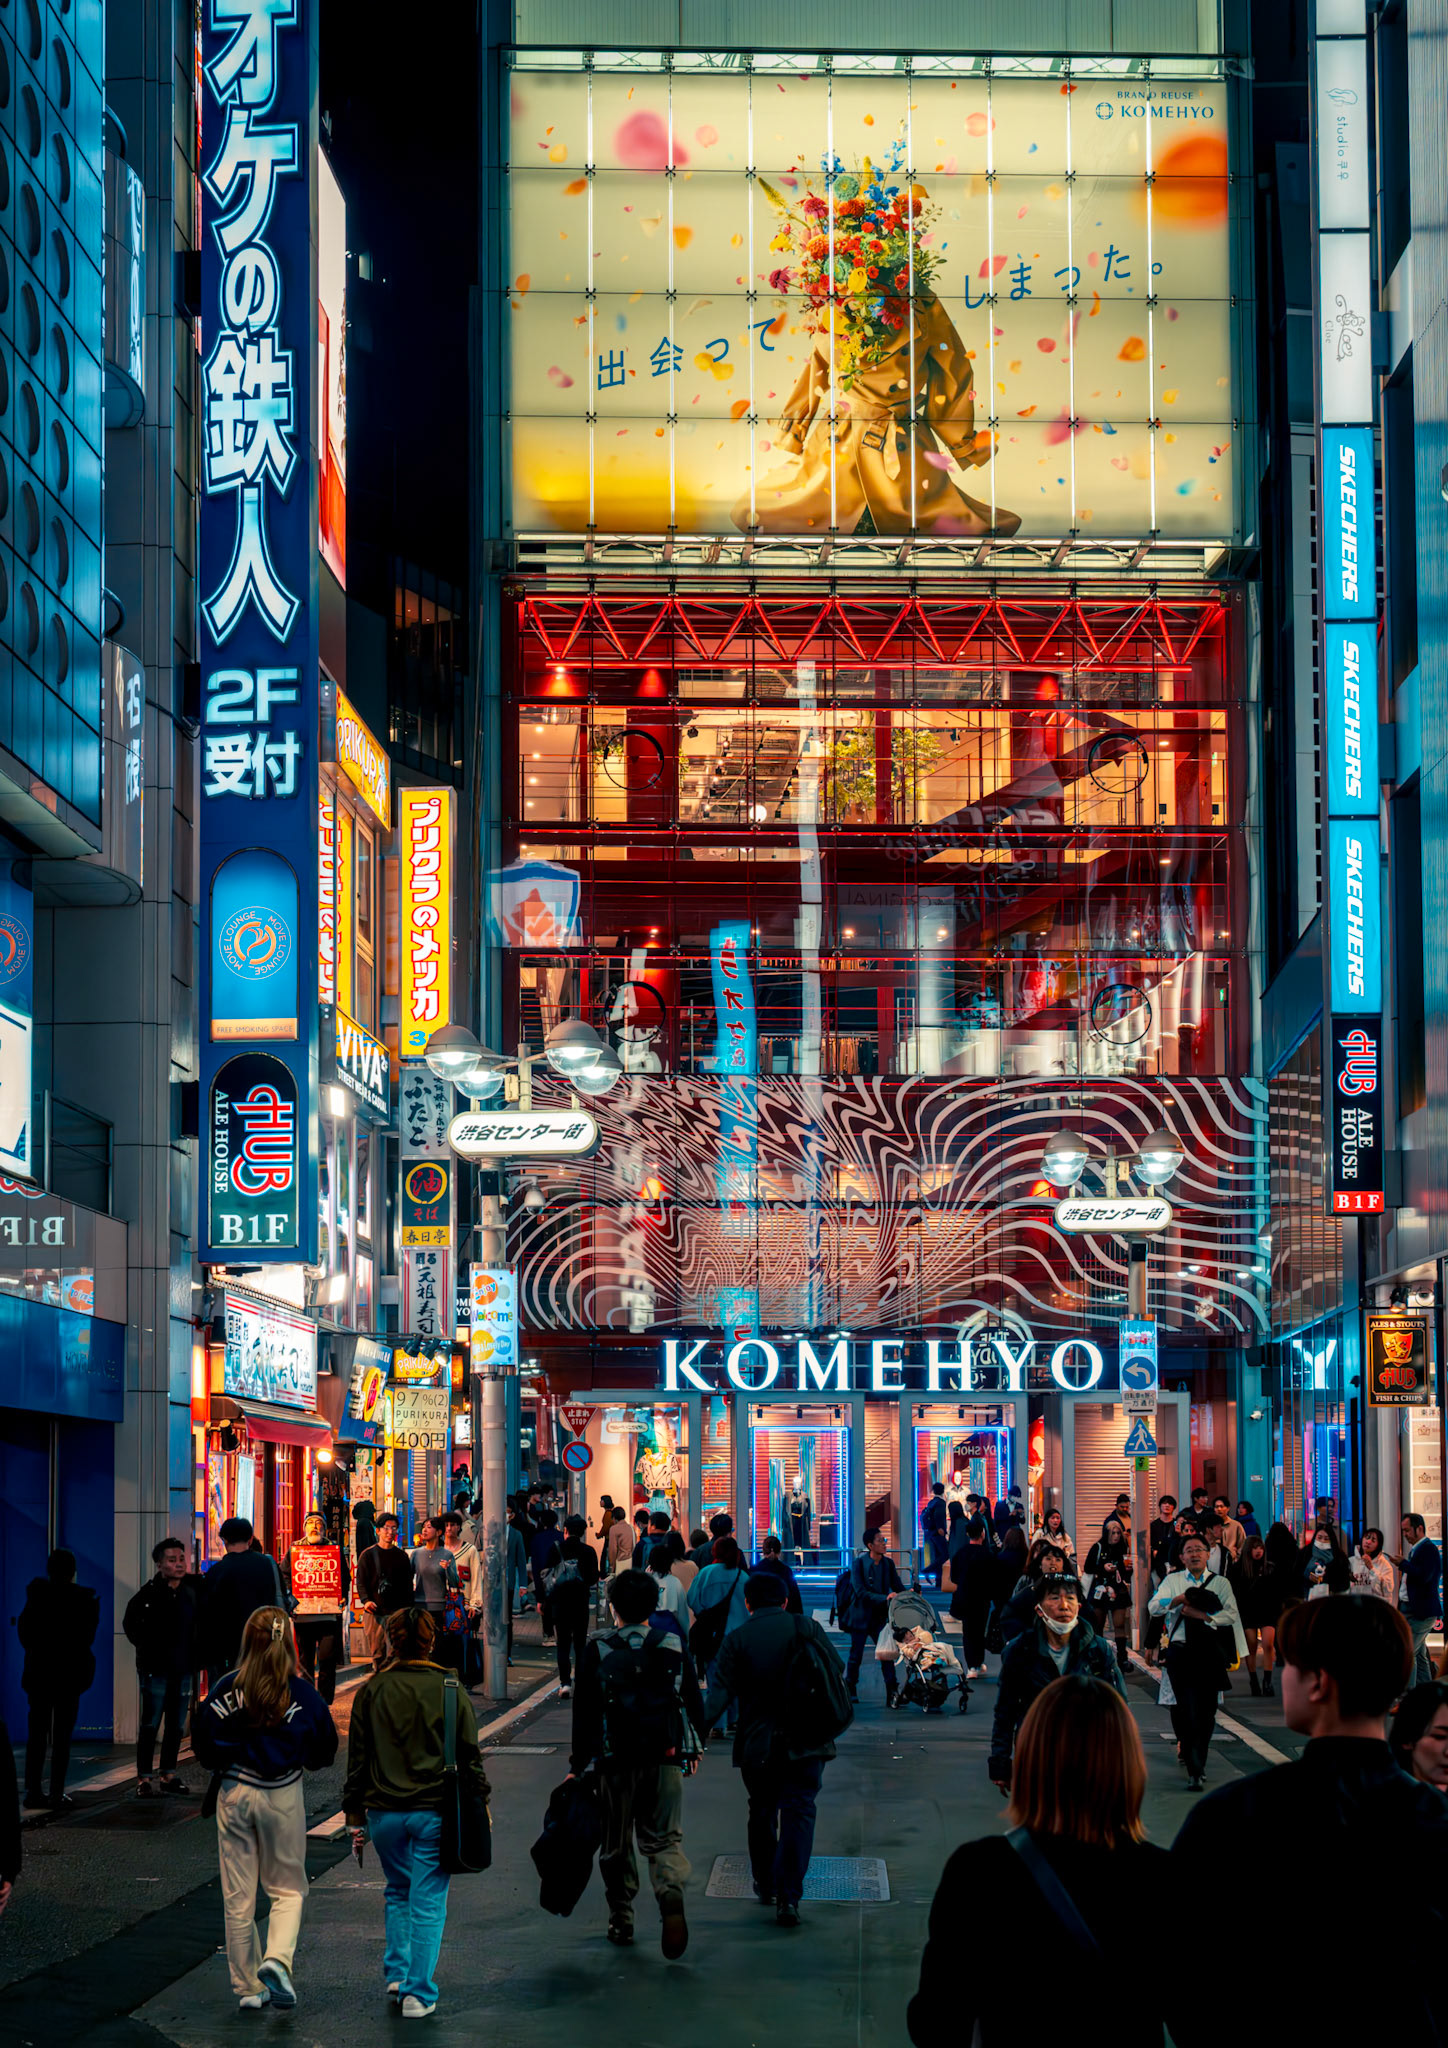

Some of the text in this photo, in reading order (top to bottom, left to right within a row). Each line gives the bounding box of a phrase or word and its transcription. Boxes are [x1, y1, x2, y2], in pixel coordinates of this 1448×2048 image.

[1117, 91, 1193, 100] BRAND REUSE
[1121, 105, 1214, 118] KOMEHYO
[1337, 116, 1348, 157] studio
[597, 317, 777, 391] 出会って
[1339, 445, 1359, 602] SKECHERS
[205, 666, 301, 725] 2F
[1343, 640, 1362, 799] SKECHERS
[205, 731, 302, 799] 受付
[337, 717, 386, 815] PRIKURA
[410, 797, 441, 1021] プリクラのメッカ
[1345, 836, 1365, 998] SKECHERS
[268, 915, 287, 941] MOVE
[224, 944, 243, 971] MOVE
[217, 1026, 233, 1034] FREE
[271, 1025, 293, 1033] SPACE
[337, 1017, 383, 1095] VIVA
[1337, 1029, 1377, 1097] HUB
[215, 1089, 229, 1193] ALE HOUSE
[230, 1082, 294, 1197] HUB
[456, 1123, 587, 1141] 渋谷センター街
[1358, 1108, 1374, 1148] ALE
[1341, 1108, 1358, 1179] HOUSE
[412, 1170, 442, 1197] 油
[414, 1206, 439, 1221] そば
[1062, 1207, 1165, 1221] 渋谷センター街
[219, 1213, 289, 1244] B1F
[406, 1230, 446, 1244] 春日亭
[415, 1266, 436, 1334] 元祖寿司
[474, 1281, 497, 1301] Enjoy
[471, 1309, 513, 1322] Welcome
[397, 1356, 435, 1373] PRIKURA
[662, 1339, 1105, 1392] KOMEHYO
[1379, 1367, 1417, 1389] HUB
[396, 1410, 448, 1420] PURIKURA
[567, 1409, 590, 1417] 止まれ
[395, 1432, 446, 1449] 400円
[294, 1559, 338, 1572] GOOD
